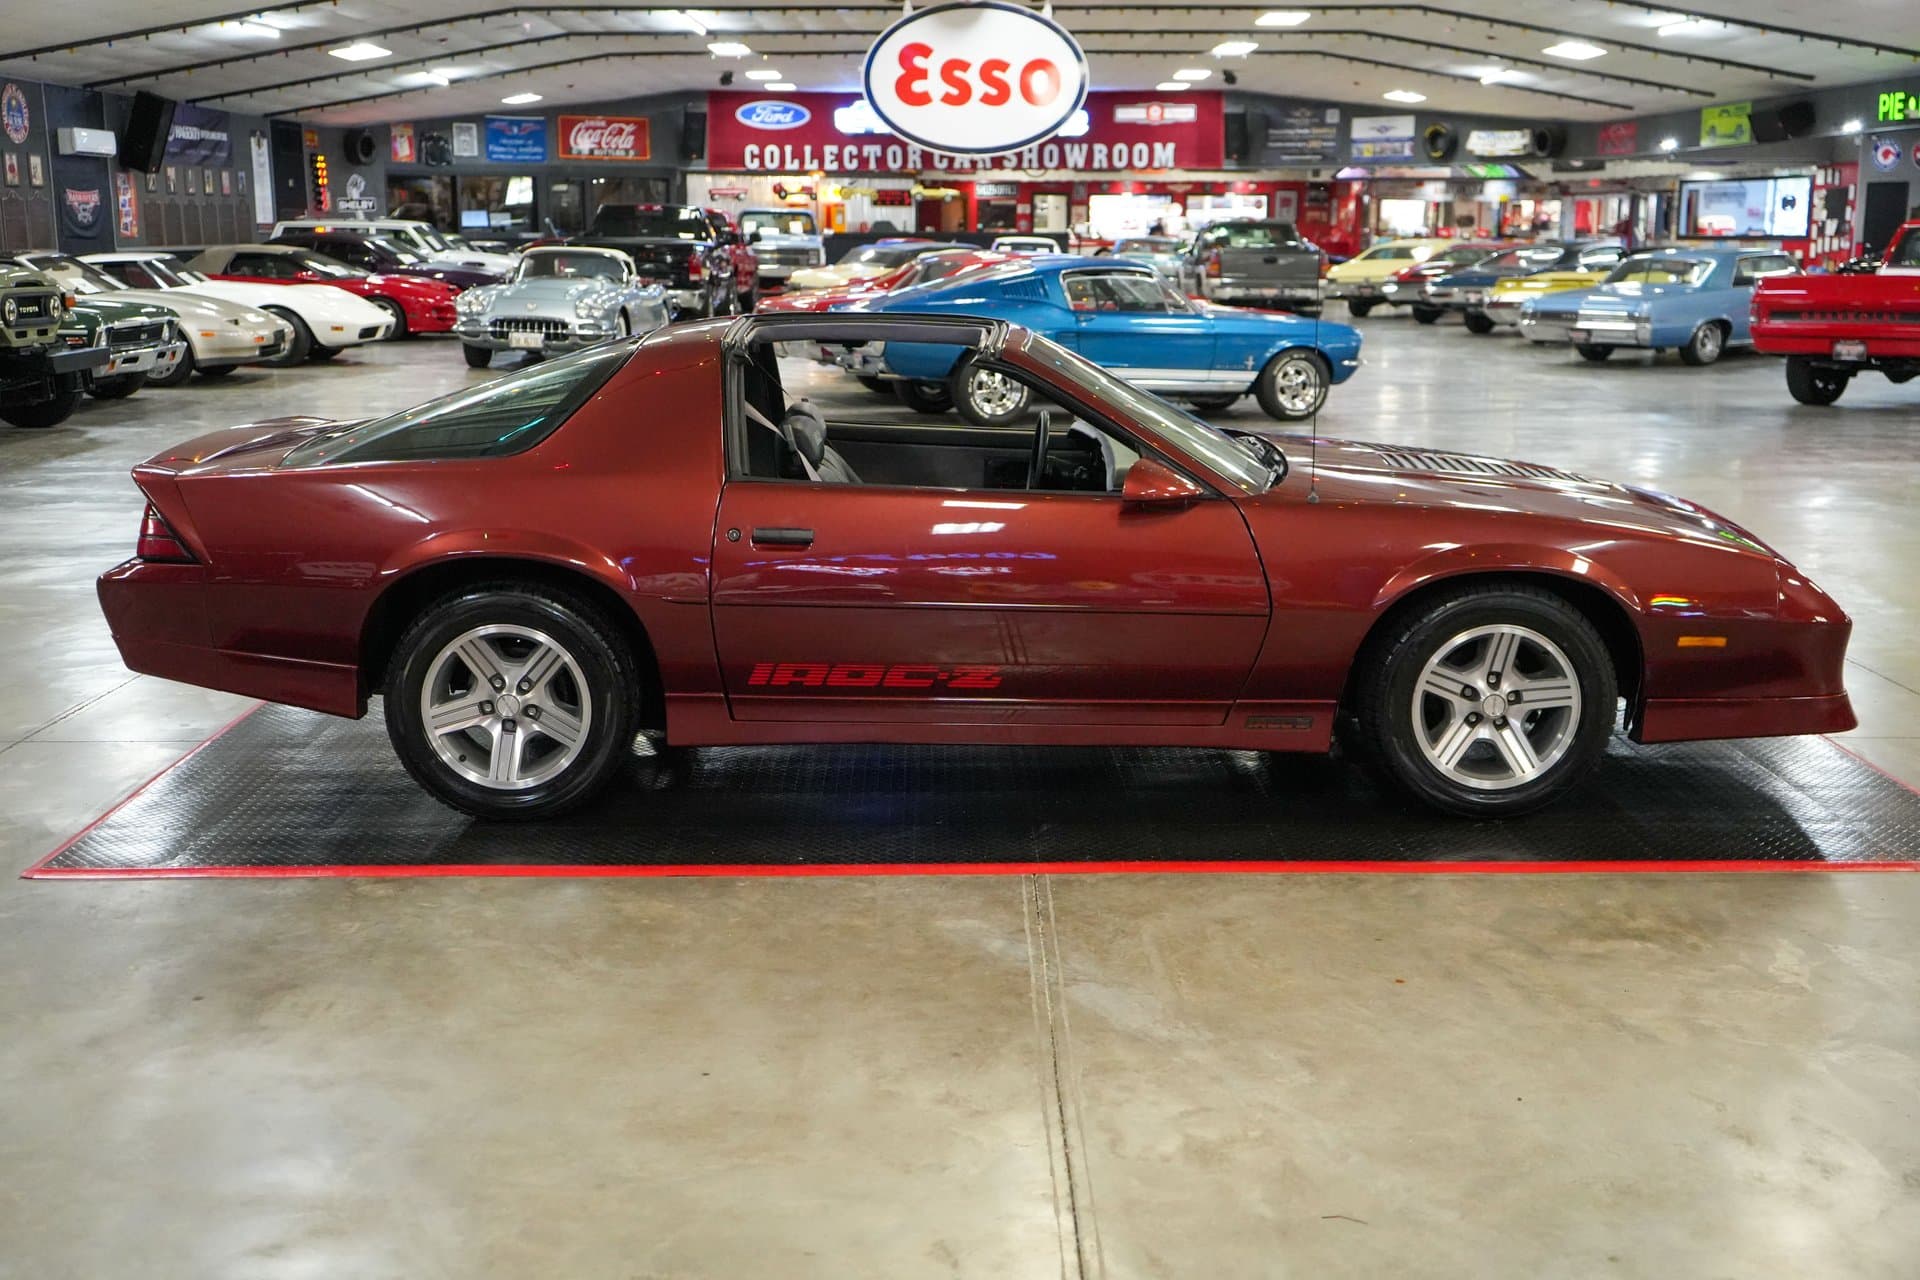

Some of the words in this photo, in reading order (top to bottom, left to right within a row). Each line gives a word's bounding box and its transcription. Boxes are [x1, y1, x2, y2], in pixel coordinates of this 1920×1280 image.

[751, 105, 795, 123] Ford
[1878, 91, 1906, 121] PIE
[743, 144, 923, 170] COLLECTOR
[1001, 142, 1177, 169] SHOWROOM
[19, 305, 40, 313] TOYOTA
[747, 663, 1002, 689] IROC-Z
